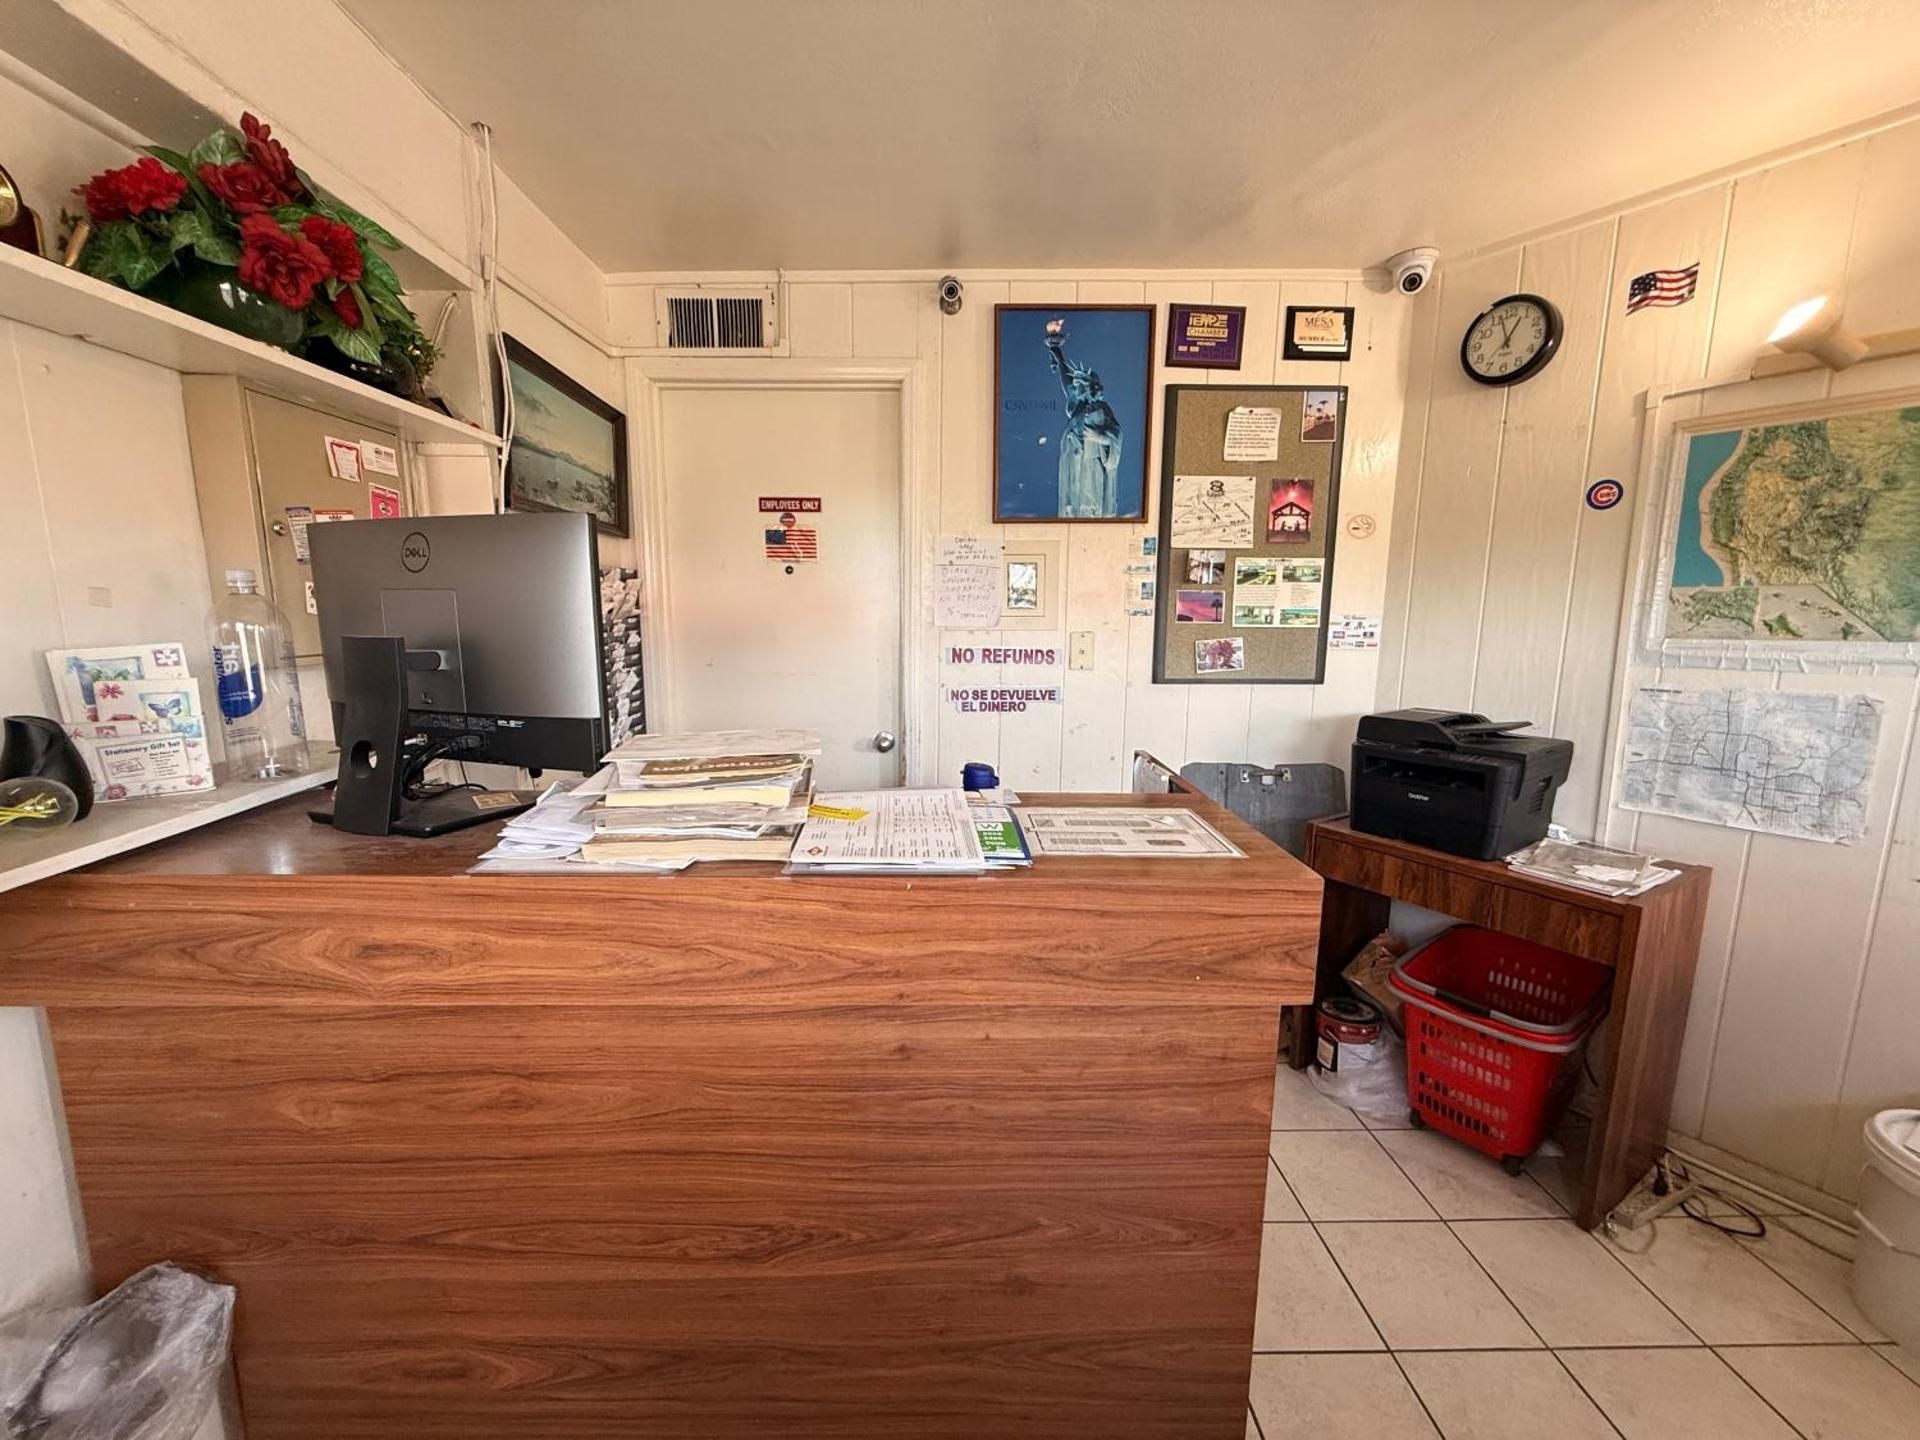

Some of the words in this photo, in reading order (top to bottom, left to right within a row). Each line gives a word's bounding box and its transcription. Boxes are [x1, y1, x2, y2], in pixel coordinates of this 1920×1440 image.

[1305, 317, 1335, 328] MESA
[1188, 328, 1227, 336] CHAMBER
[760, 500, 801, 510] EMPLOYEES
[801, 500, 819, 510] ONLY
[405, 548, 427, 558] DELL
[951, 647, 975, 664] NO
[981, 648, 1056, 665] REFUNDS
[950, 689, 969, 701] NO
[971, 690, 988, 701] SE
[991, 690, 1056, 701] DEVUELVE
[961, 701, 977, 712] EL
[979, 701, 1026, 712] DINERO
[150, 742, 166, 751] Gift
